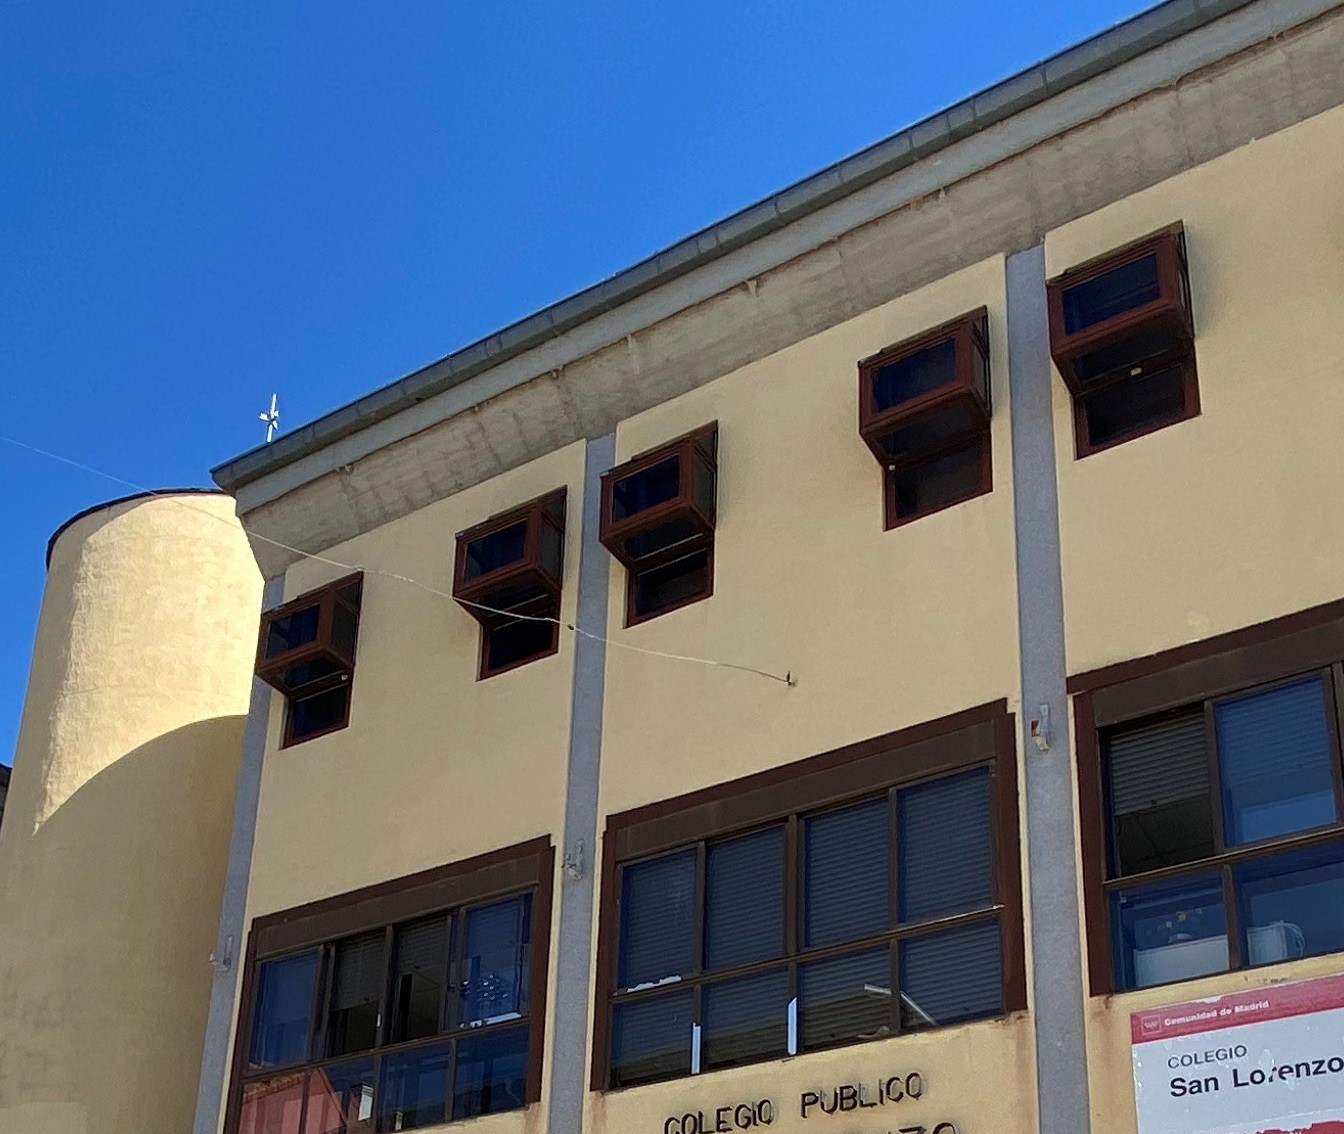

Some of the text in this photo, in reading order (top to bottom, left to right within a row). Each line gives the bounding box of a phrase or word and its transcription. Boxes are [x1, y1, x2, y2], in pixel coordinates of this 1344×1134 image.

[1164, 1000, 1269, 1027] Comunidad de Madrid
[1167, 1044, 1247, 1069] COLEGIO
[801, 1072, 924, 1119] PUBLICO
[1170, 1075, 1219, 1097] San
